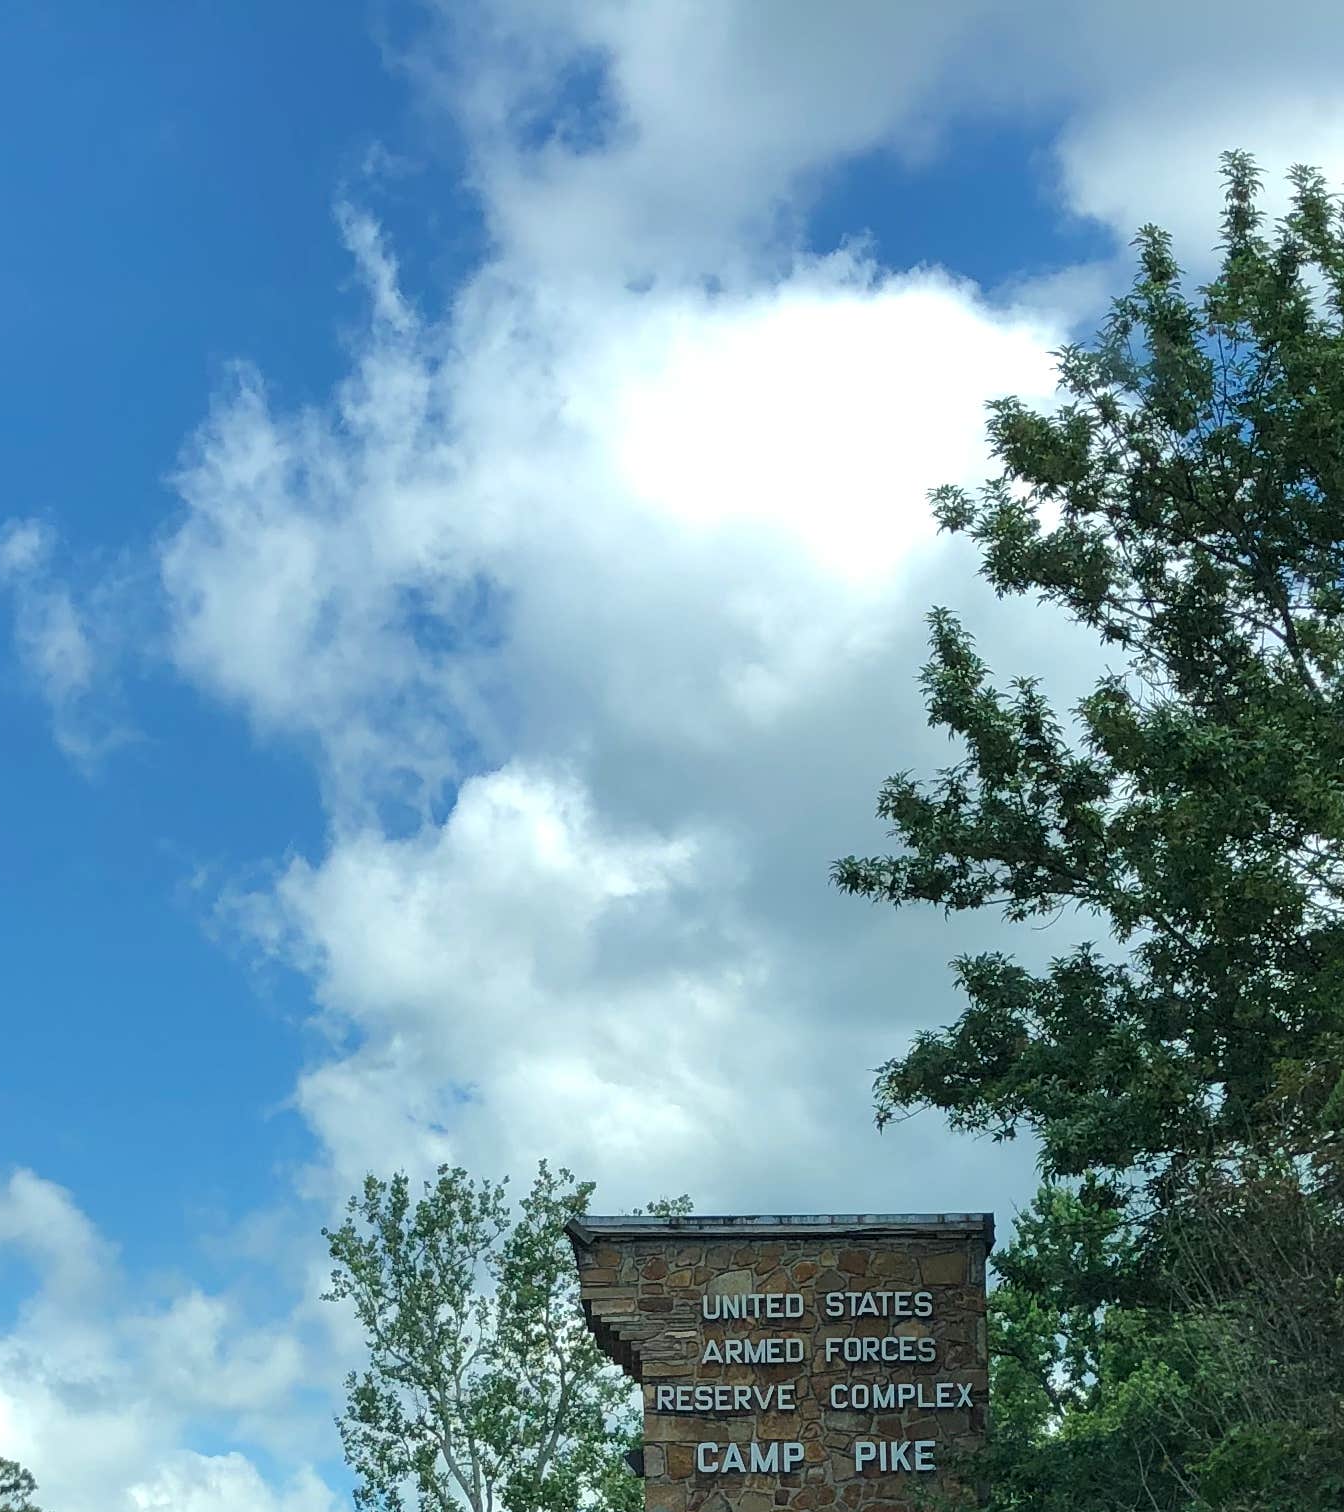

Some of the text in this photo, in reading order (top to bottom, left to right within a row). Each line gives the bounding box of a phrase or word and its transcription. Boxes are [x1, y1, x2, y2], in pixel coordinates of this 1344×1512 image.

[702, 1290, 934, 1320] UNITED STATES
[701, 1335, 937, 1365] ARMED FORCES
[656, 1381, 975, 1411] RESERVE COMPLEX
[696, 1439, 937, 1473] CAMP PIKE
